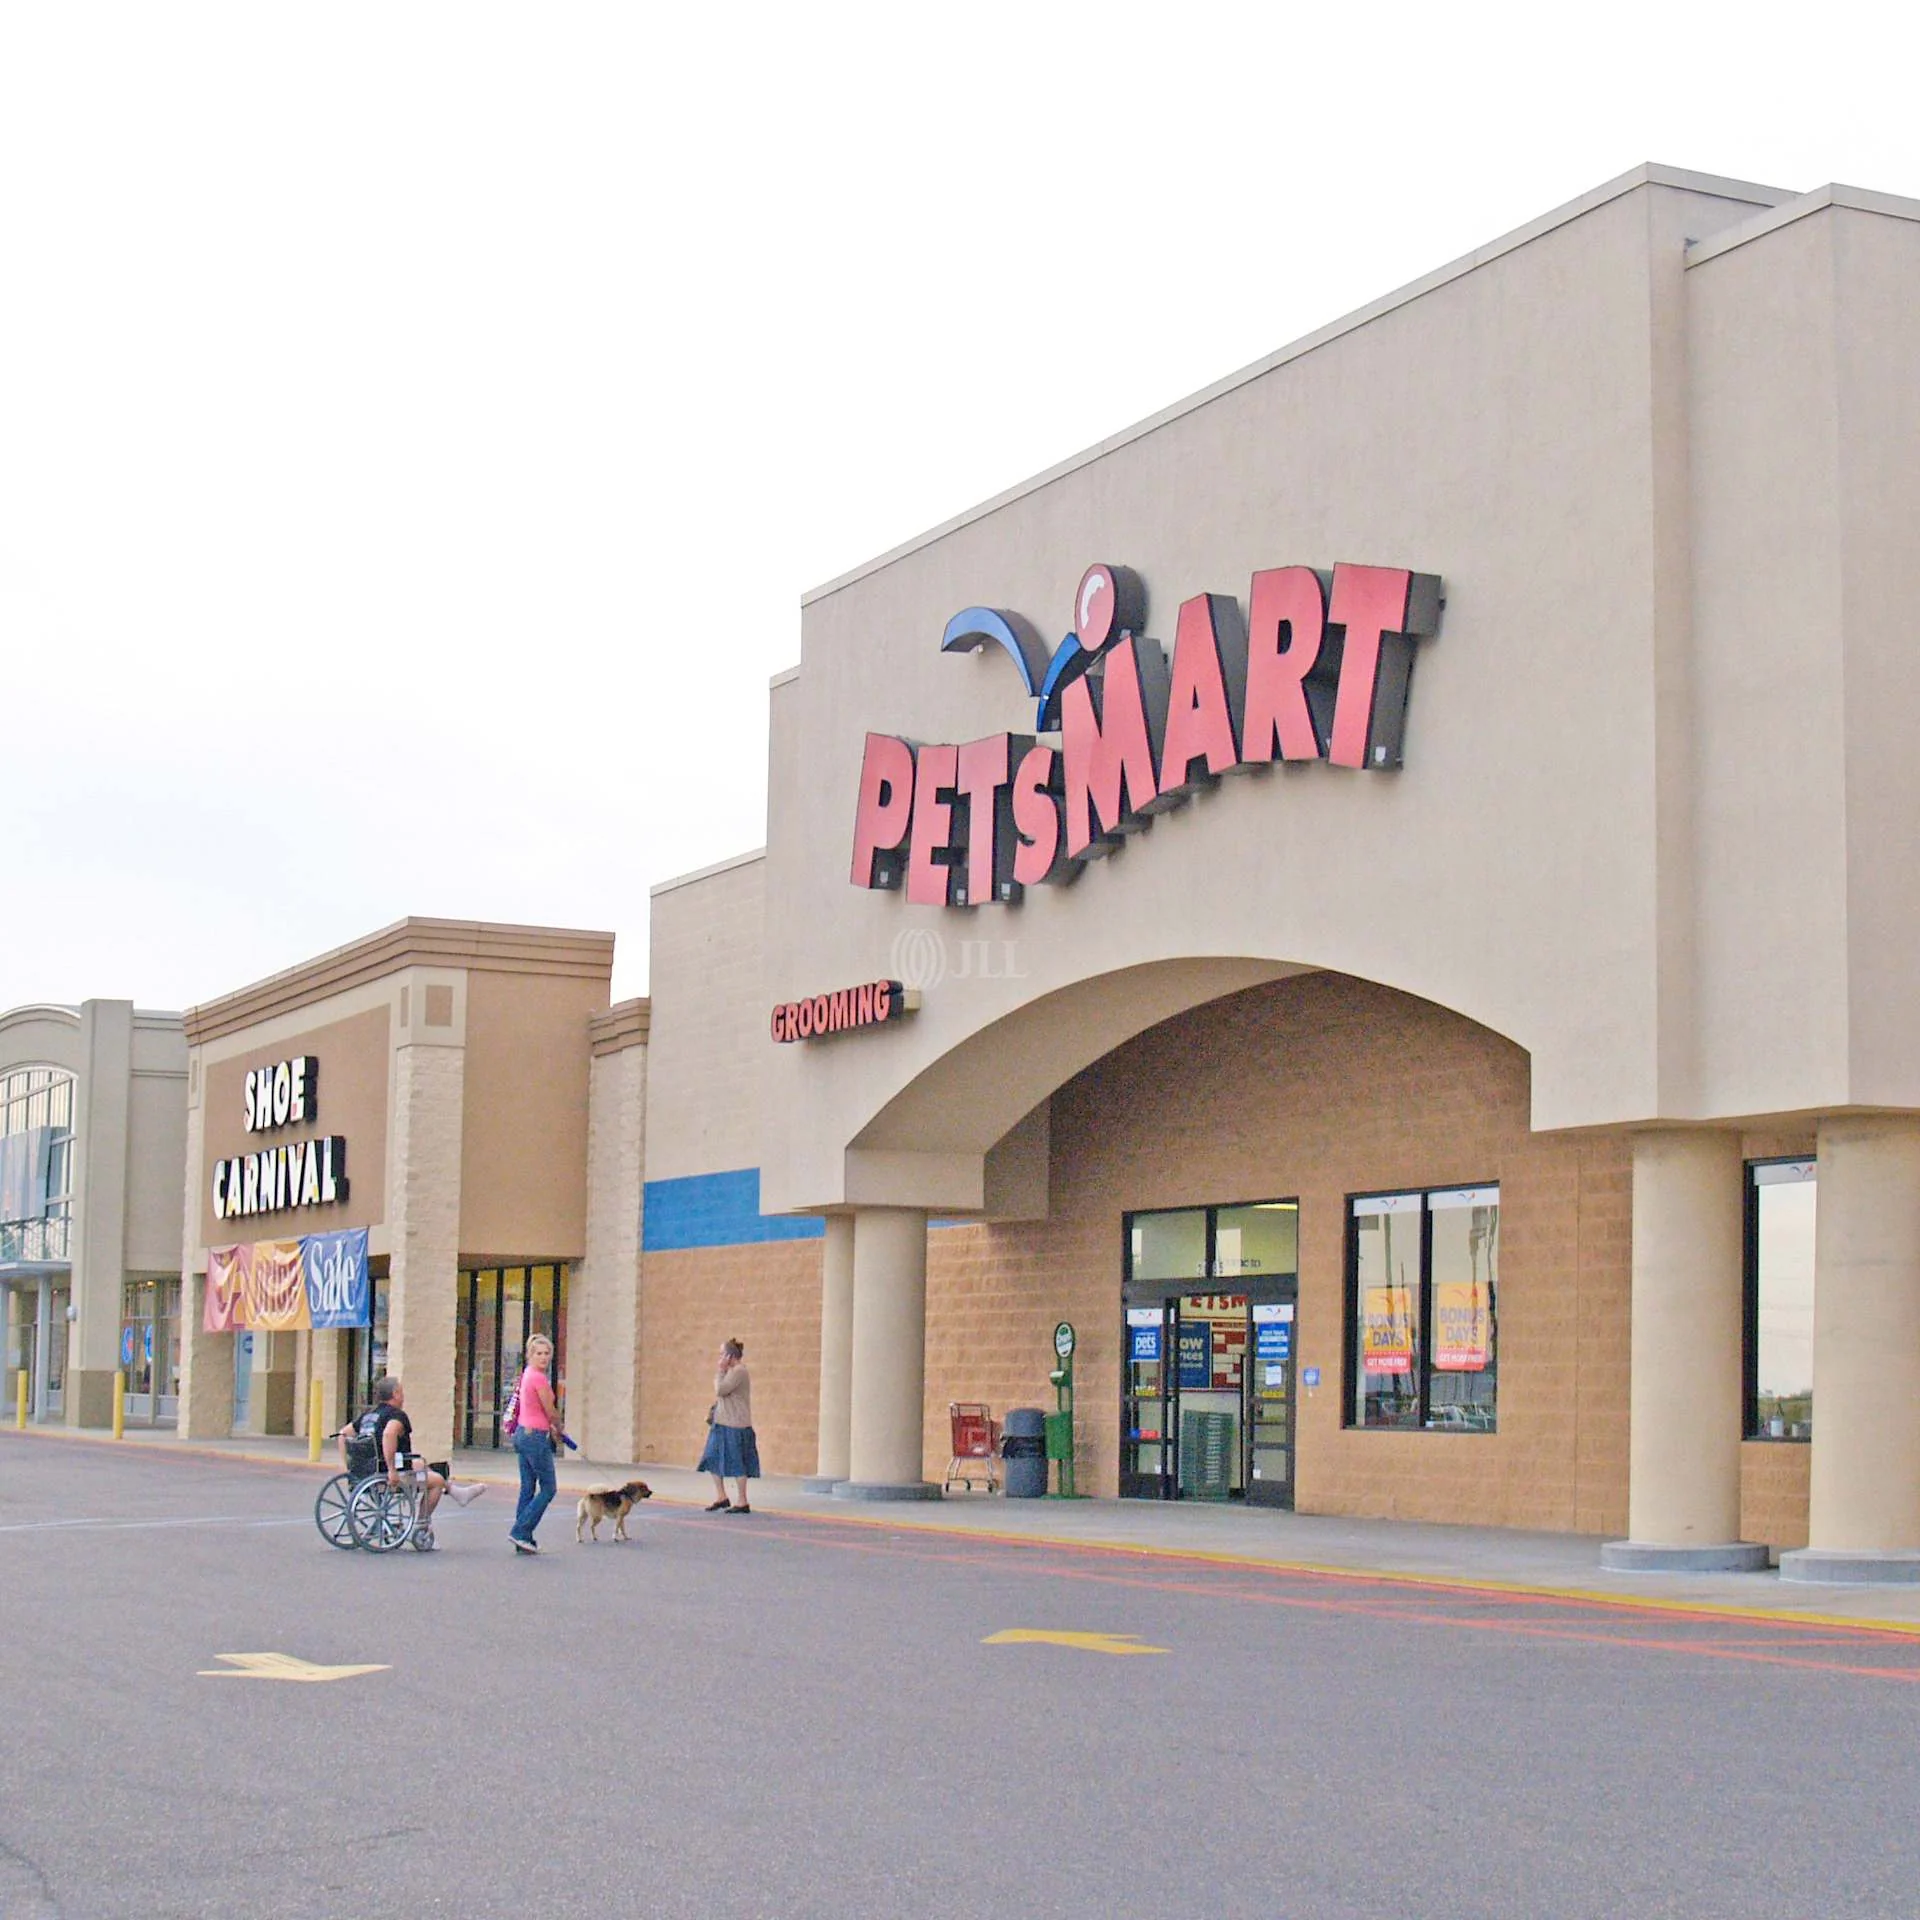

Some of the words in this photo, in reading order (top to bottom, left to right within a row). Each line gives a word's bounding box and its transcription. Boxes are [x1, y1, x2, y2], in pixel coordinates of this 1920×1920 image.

[851, 562, 1414, 906] PETSMART
[771, 979, 890, 1043] GROOMING
[243, 1055, 307, 1133] SHOE
[213, 1135, 337, 1220] CARNIVAL
[1373, 1331, 1404, 1346] DAYS
[1446, 1324, 1478, 1344] DAYS
